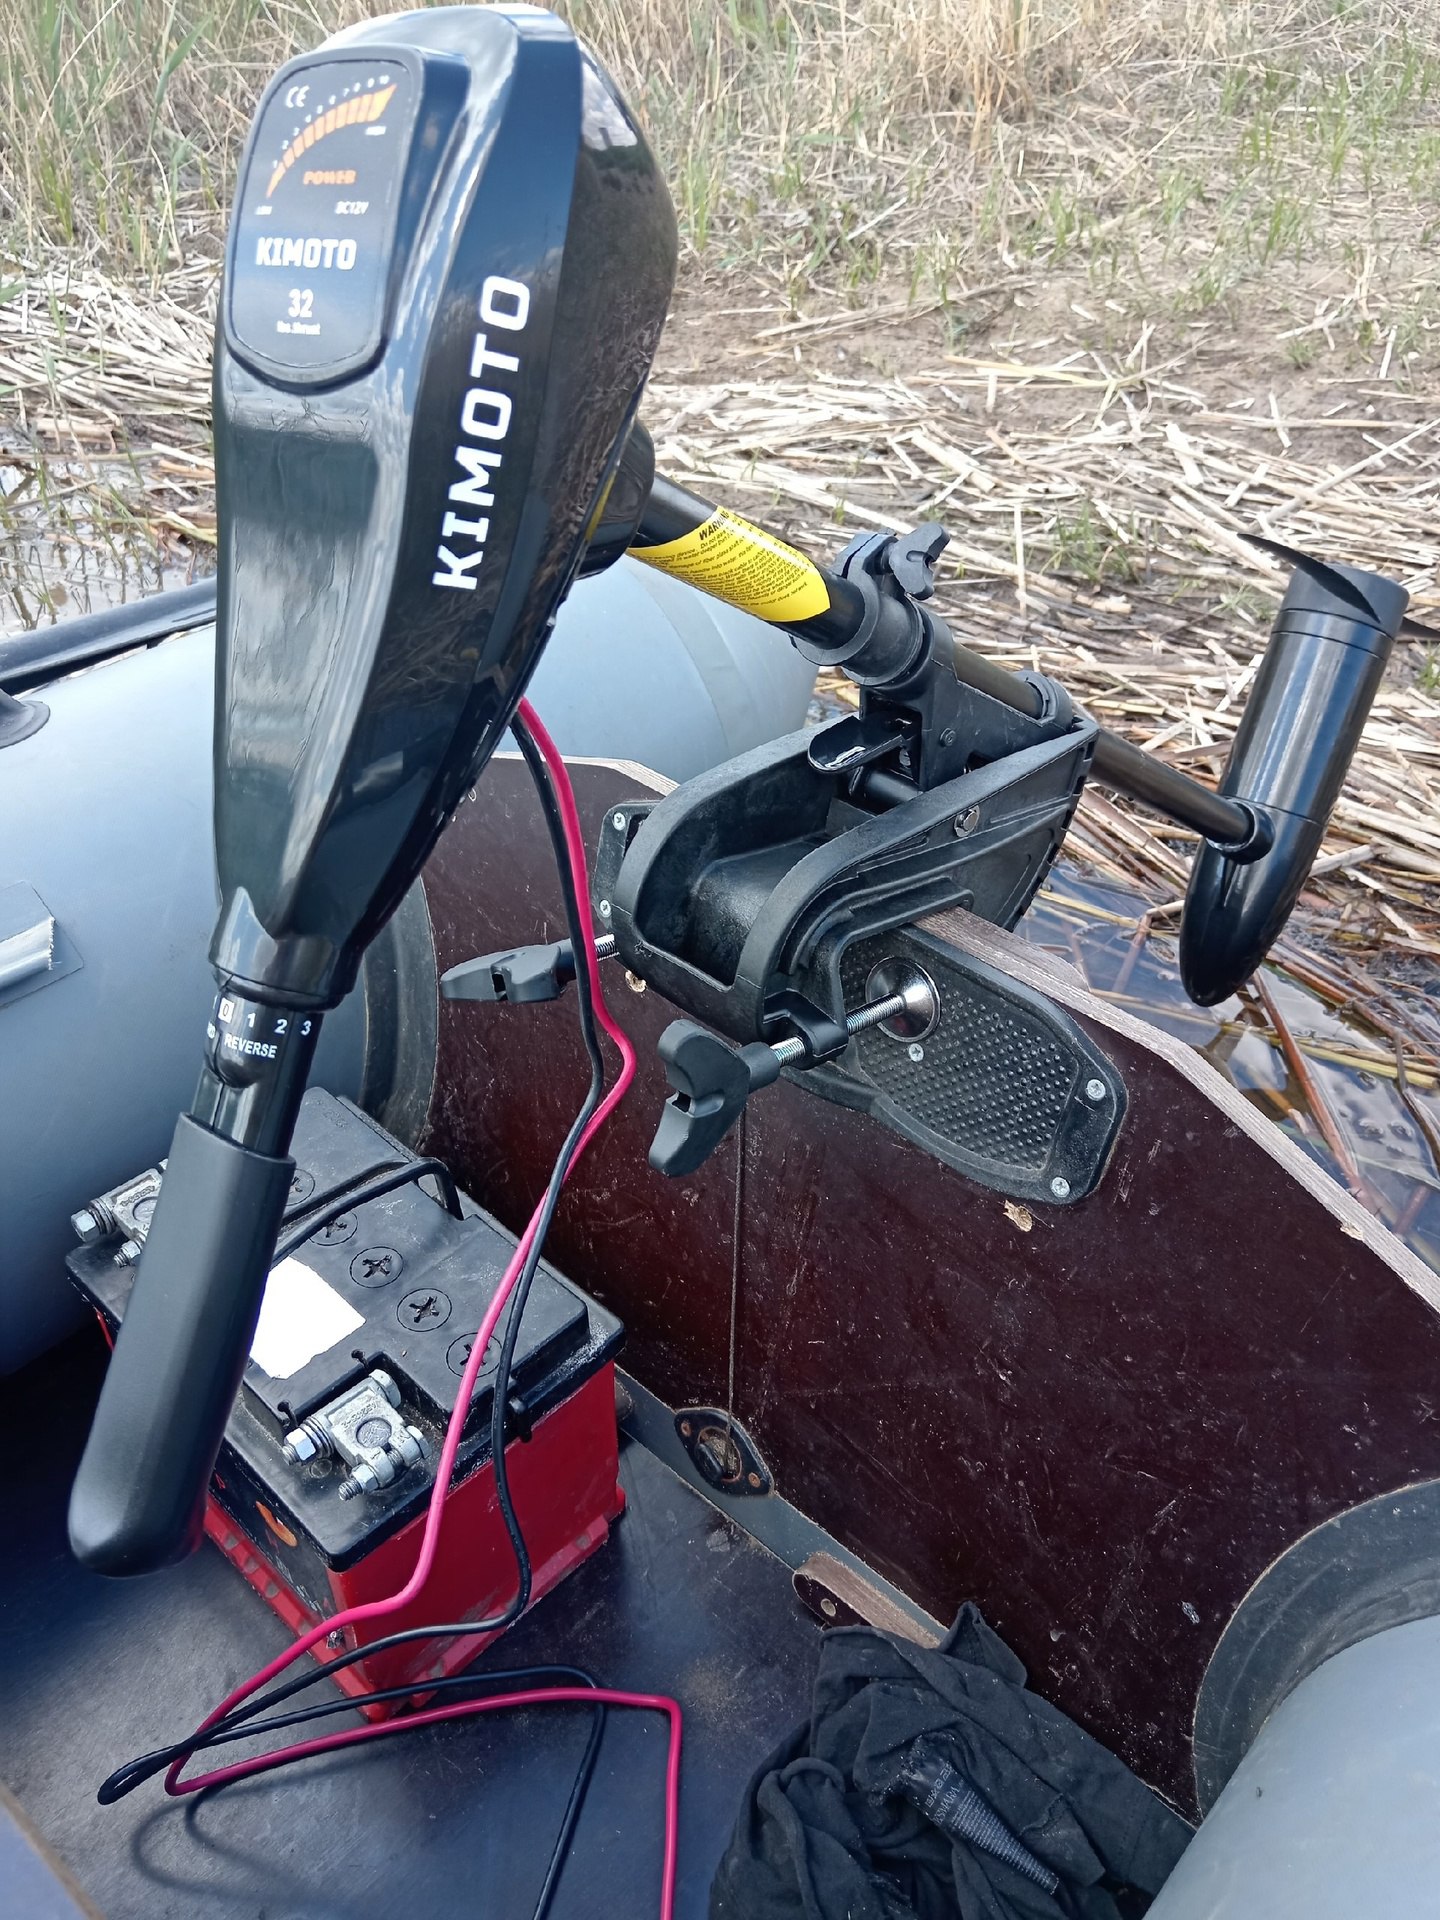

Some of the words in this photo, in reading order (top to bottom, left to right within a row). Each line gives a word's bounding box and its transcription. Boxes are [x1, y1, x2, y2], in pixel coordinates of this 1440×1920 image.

[303, 170, 357, 185] POWER
[256, 237, 357, 270] KIMOTO
[288, 288, 314, 318] 32
[432, 275, 530, 590] KIMOTO
[247, 1012, 256, 1028] 1
[274, 1018, 288, 1035] 2
[300, 1020, 312, 1036] 3
[224, 1032, 278, 1059] REVERSE
